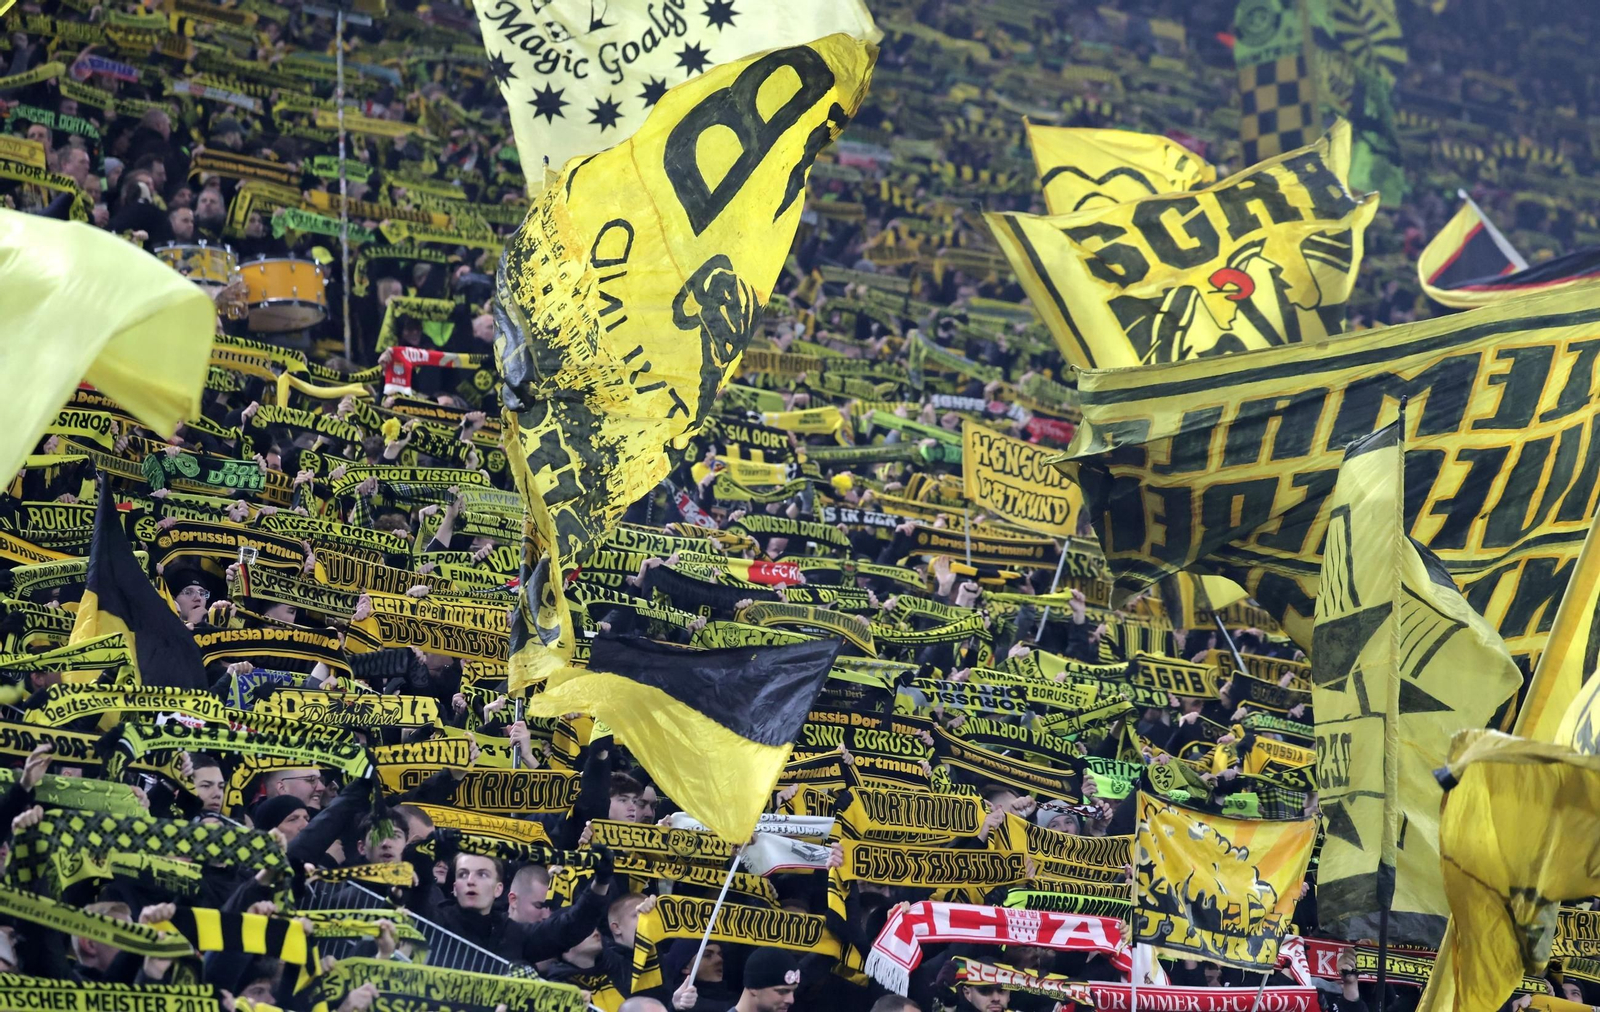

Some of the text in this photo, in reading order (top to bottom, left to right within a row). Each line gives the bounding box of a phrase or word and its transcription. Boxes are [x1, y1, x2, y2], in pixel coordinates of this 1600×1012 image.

[485, 2, 588, 78] Magic
[170, 529, 236, 547] Borussia
[980, 541, 1033, 555] Dortmund
[40, 561, 82, 578] DORTMUND
[250, 570, 294, 595] SUPER
[264, 629, 341, 651] Dortmund
[45, 693, 227, 722] Deutscher Meister 2011
[922, 691, 1027, 714] BORUSSIA
[300, 704, 401, 727] Dortmund
[860, 789, 979, 832] DORTMUND
[853, 845, 1026, 885] SÜDTRIBÜNE
[656, 895, 825, 947] DORTMUND
[85, 993, 168, 1012] MEISTER
[175, 996, 214, 1012] 2011
[1255, 990, 1312, 1012] KÖLN
